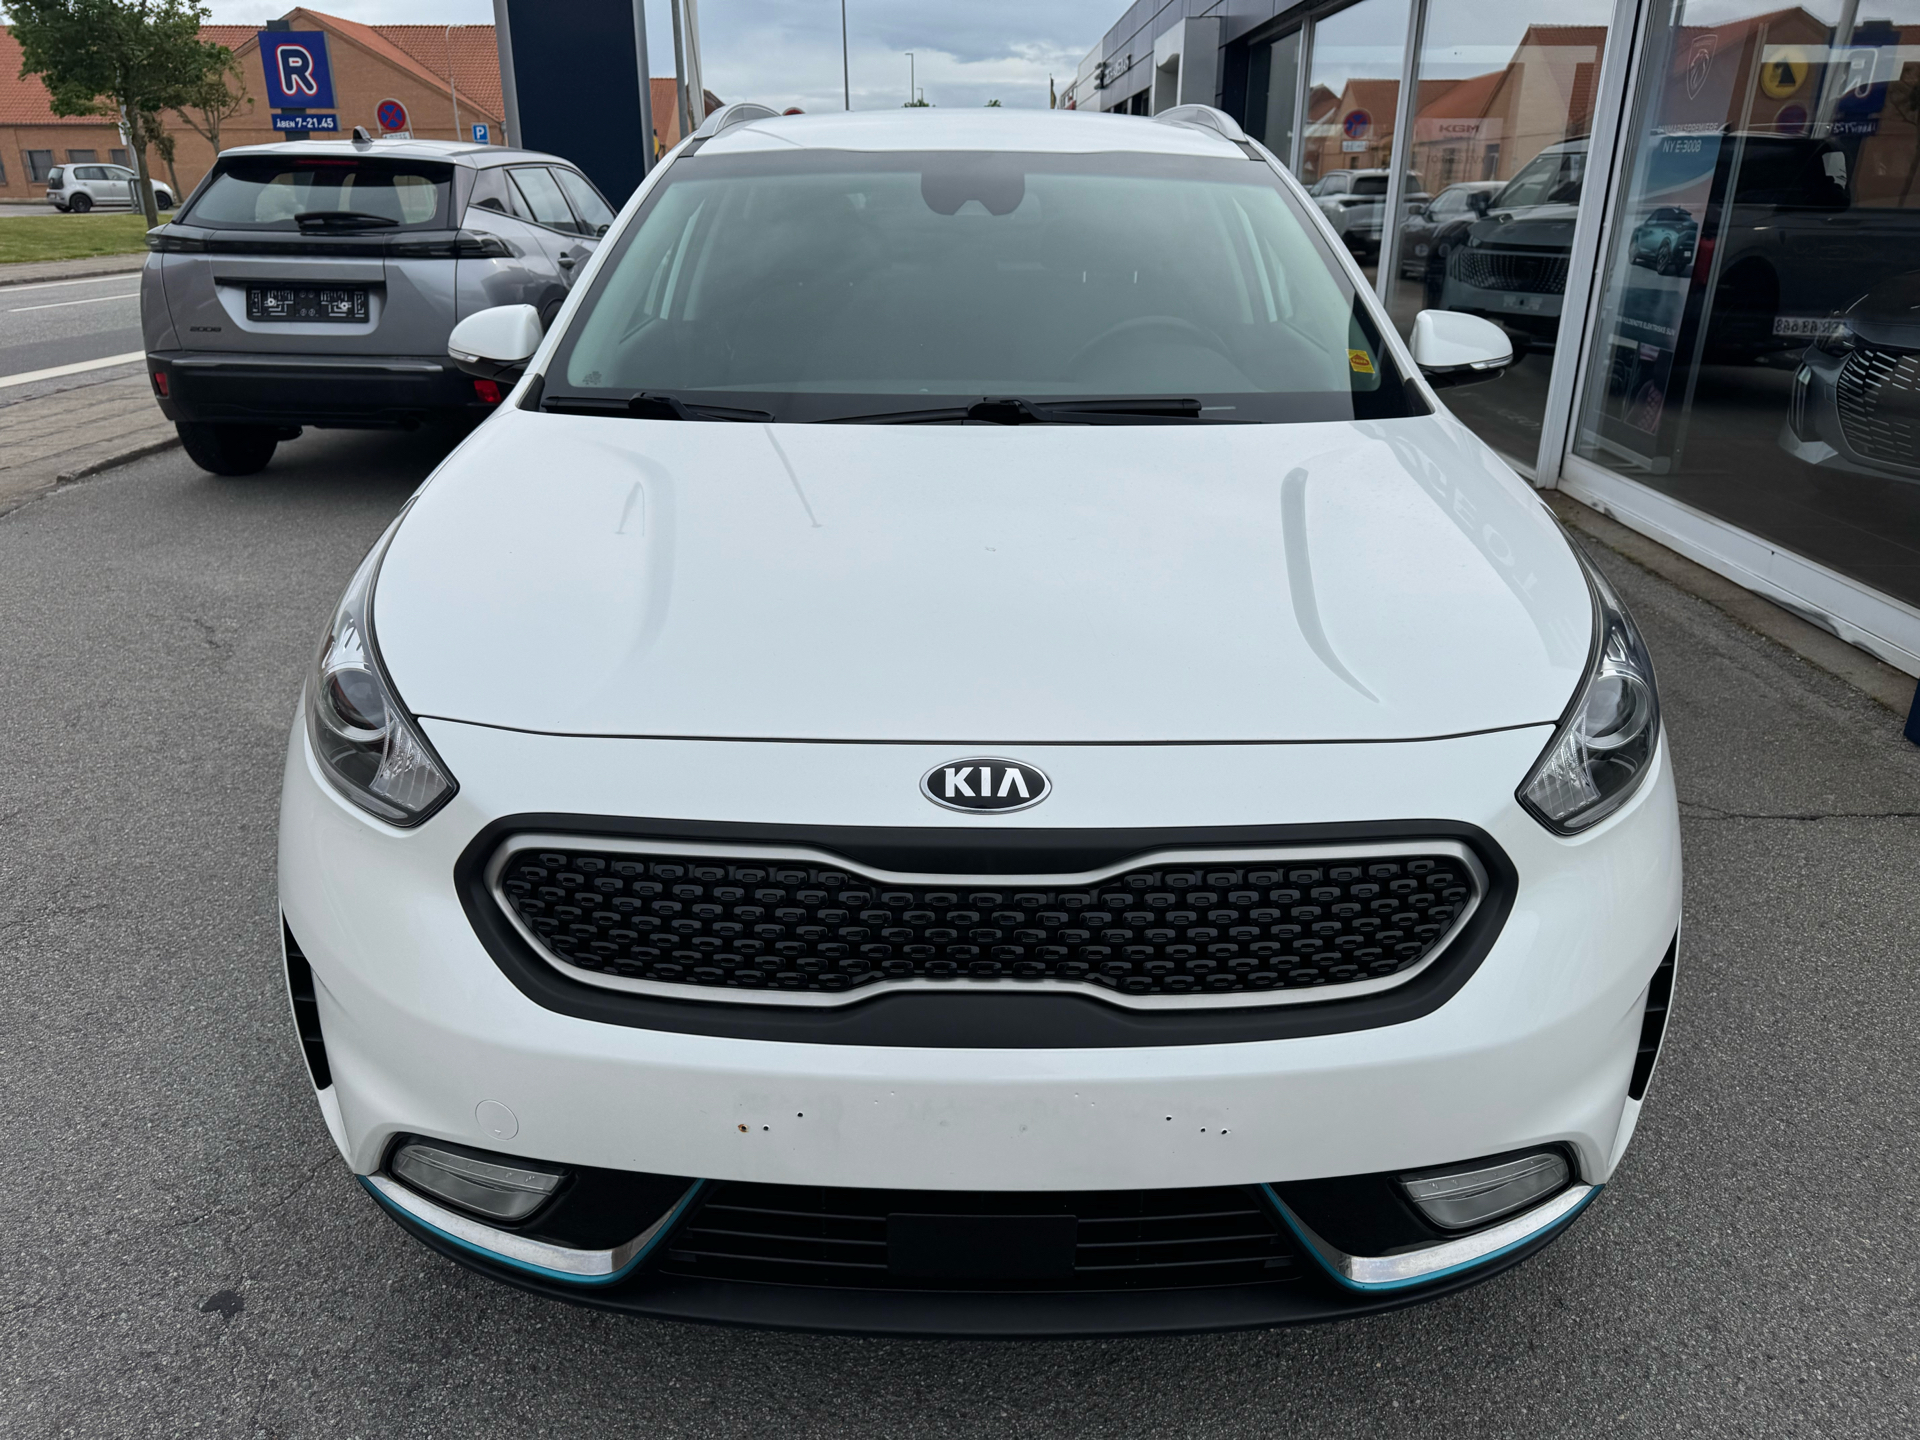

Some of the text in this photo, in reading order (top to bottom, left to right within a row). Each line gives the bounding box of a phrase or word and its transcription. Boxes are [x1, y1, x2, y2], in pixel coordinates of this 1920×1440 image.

[275, 44, 318, 96] R
[276, 117, 334, 128] ÅBEN 7-21.45
[1439, 124, 1480, 133] KGM
[476, 126, 485, 139] P
[1662, 139, 1702, 153] NY E-3008
[943, 766, 1030, 798] KIA
